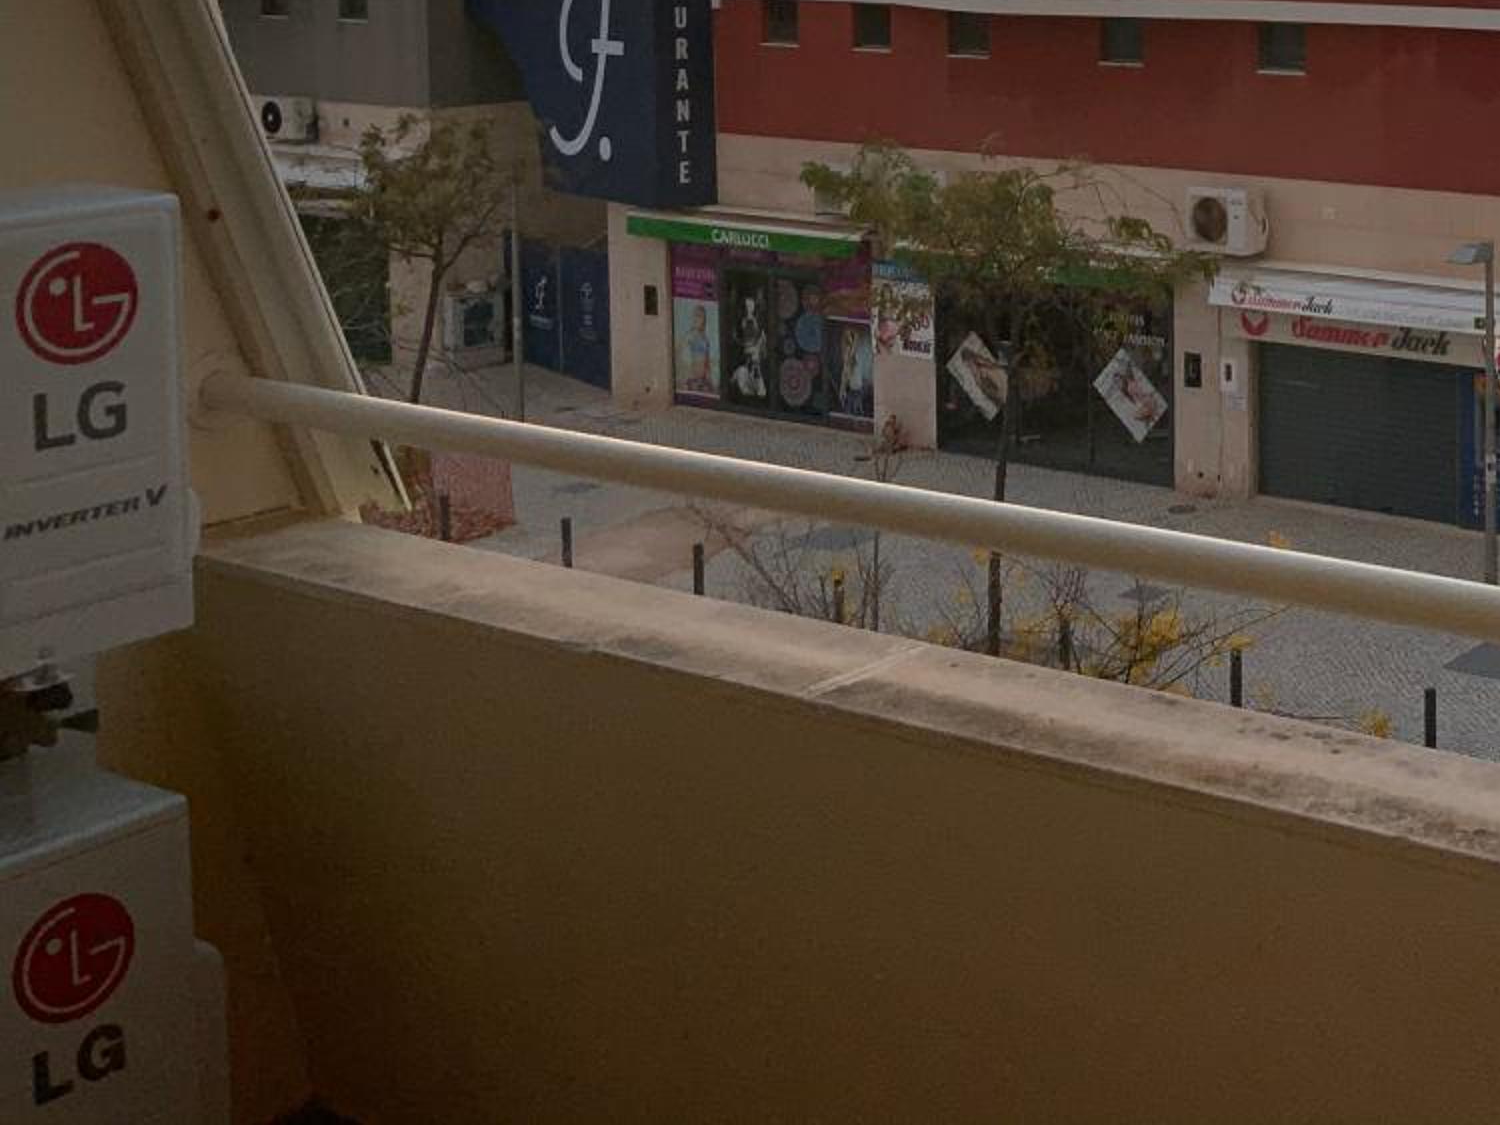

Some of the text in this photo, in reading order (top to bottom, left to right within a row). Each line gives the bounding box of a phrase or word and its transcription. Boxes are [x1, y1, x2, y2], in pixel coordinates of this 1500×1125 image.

[711, 228, 769, 250] CARLUCCI
[1292, 315, 1390, 348] Summer
[1391, 325, 1452, 357] Jack
[33, 380, 128, 452] LG
[3, 483, 169, 542] INVERTER V
[31, 1023, 127, 1107] LG
